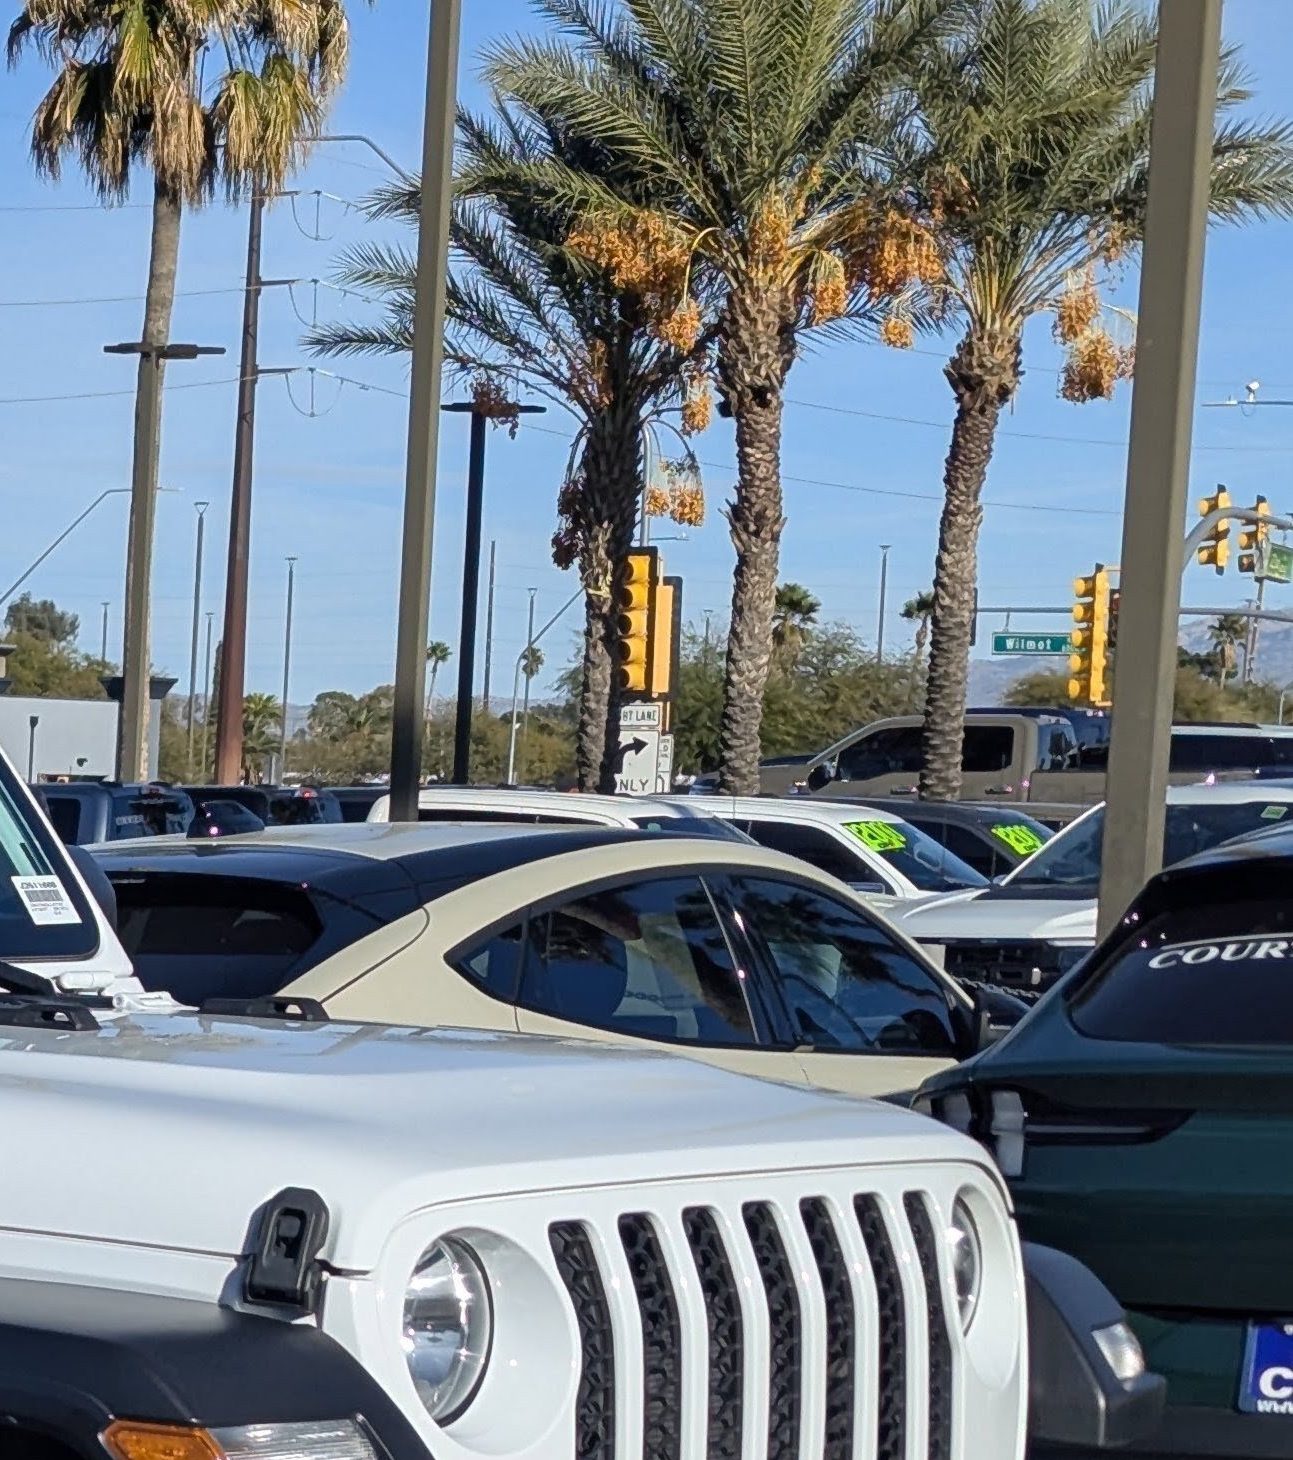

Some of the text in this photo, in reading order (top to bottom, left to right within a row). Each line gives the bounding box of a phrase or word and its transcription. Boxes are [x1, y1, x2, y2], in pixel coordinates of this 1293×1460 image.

[1005, 638, 1052, 650] Wilmot
[619, 779, 648, 791] NLY
[1148, 940, 1293, 969] COUR
